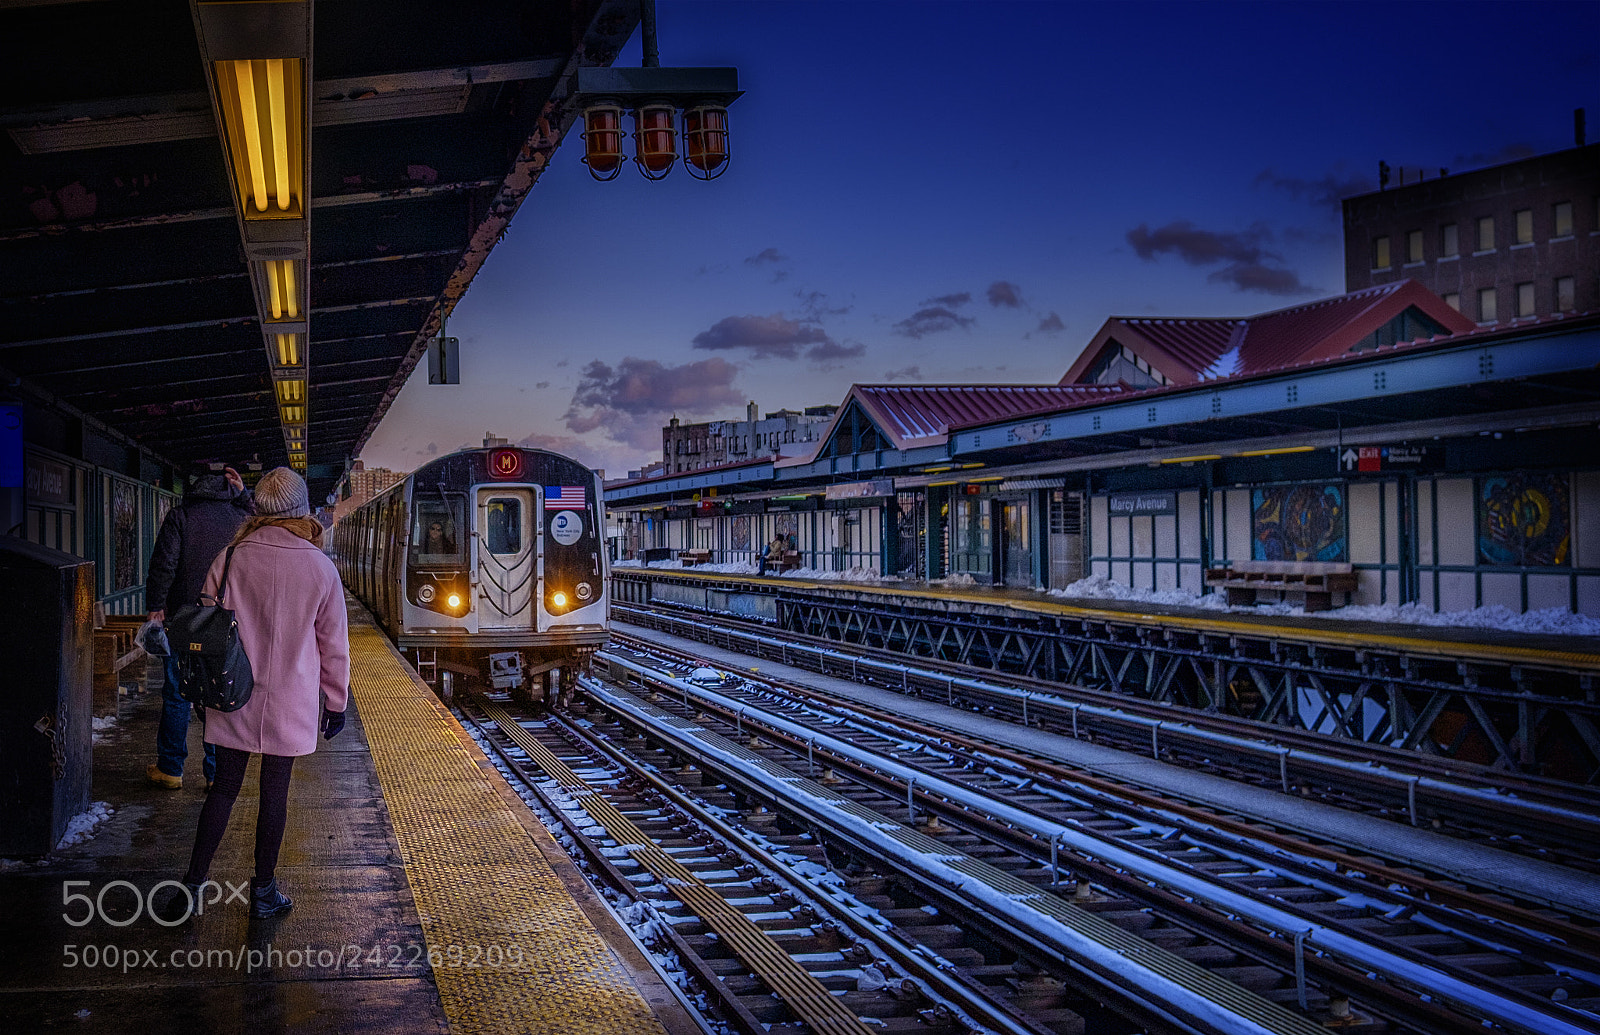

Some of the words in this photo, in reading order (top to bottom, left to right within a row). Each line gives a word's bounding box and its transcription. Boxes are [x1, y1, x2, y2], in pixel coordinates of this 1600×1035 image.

[1359, 447, 1379, 458] Exit
[502, 455, 511, 469] M
[27, 468, 41, 496] arcy
[1110, 498, 1135, 513] Marcy
[1136, 497, 1167, 509] Avenue
